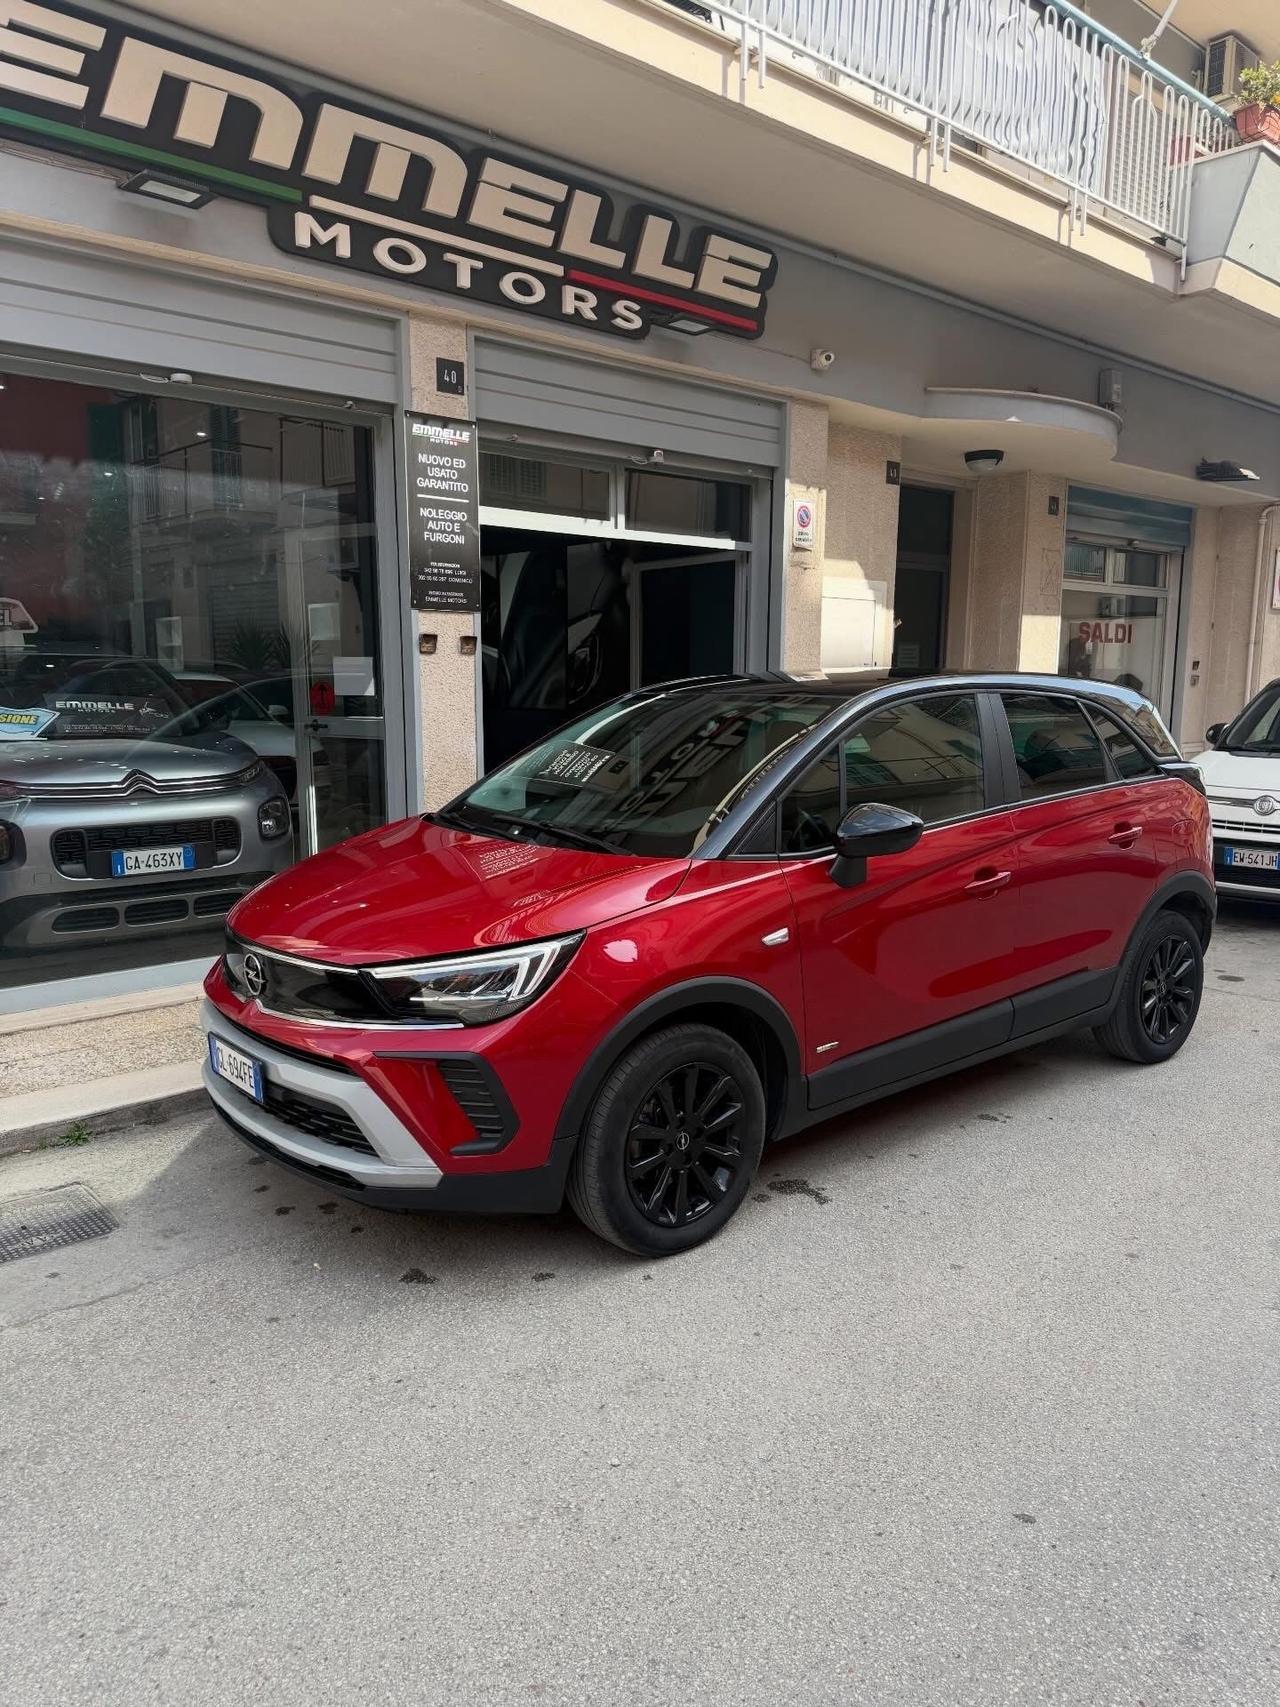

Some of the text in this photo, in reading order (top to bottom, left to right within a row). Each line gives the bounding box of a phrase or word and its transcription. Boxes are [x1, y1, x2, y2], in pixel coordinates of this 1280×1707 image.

[0, 1, 773, 309] EMMELLE
[294, 211, 644, 331] MOTORS
[444, 369, 457, 384] 40
[412, 423, 470, 442] EMMELLE
[418, 453, 466, 468] NUOVO ED
[427, 466, 458, 479] USATO
[416, 477, 469, 492] GARANTITO
[420, 507, 467, 521] NOLEGGIO
[427, 520, 460, 532] AUTO E
[424, 532, 465, 545] FURGONI
[1079, 621, 1133, 644] SALDI
[55, 701, 134, 710] EMMELLE
